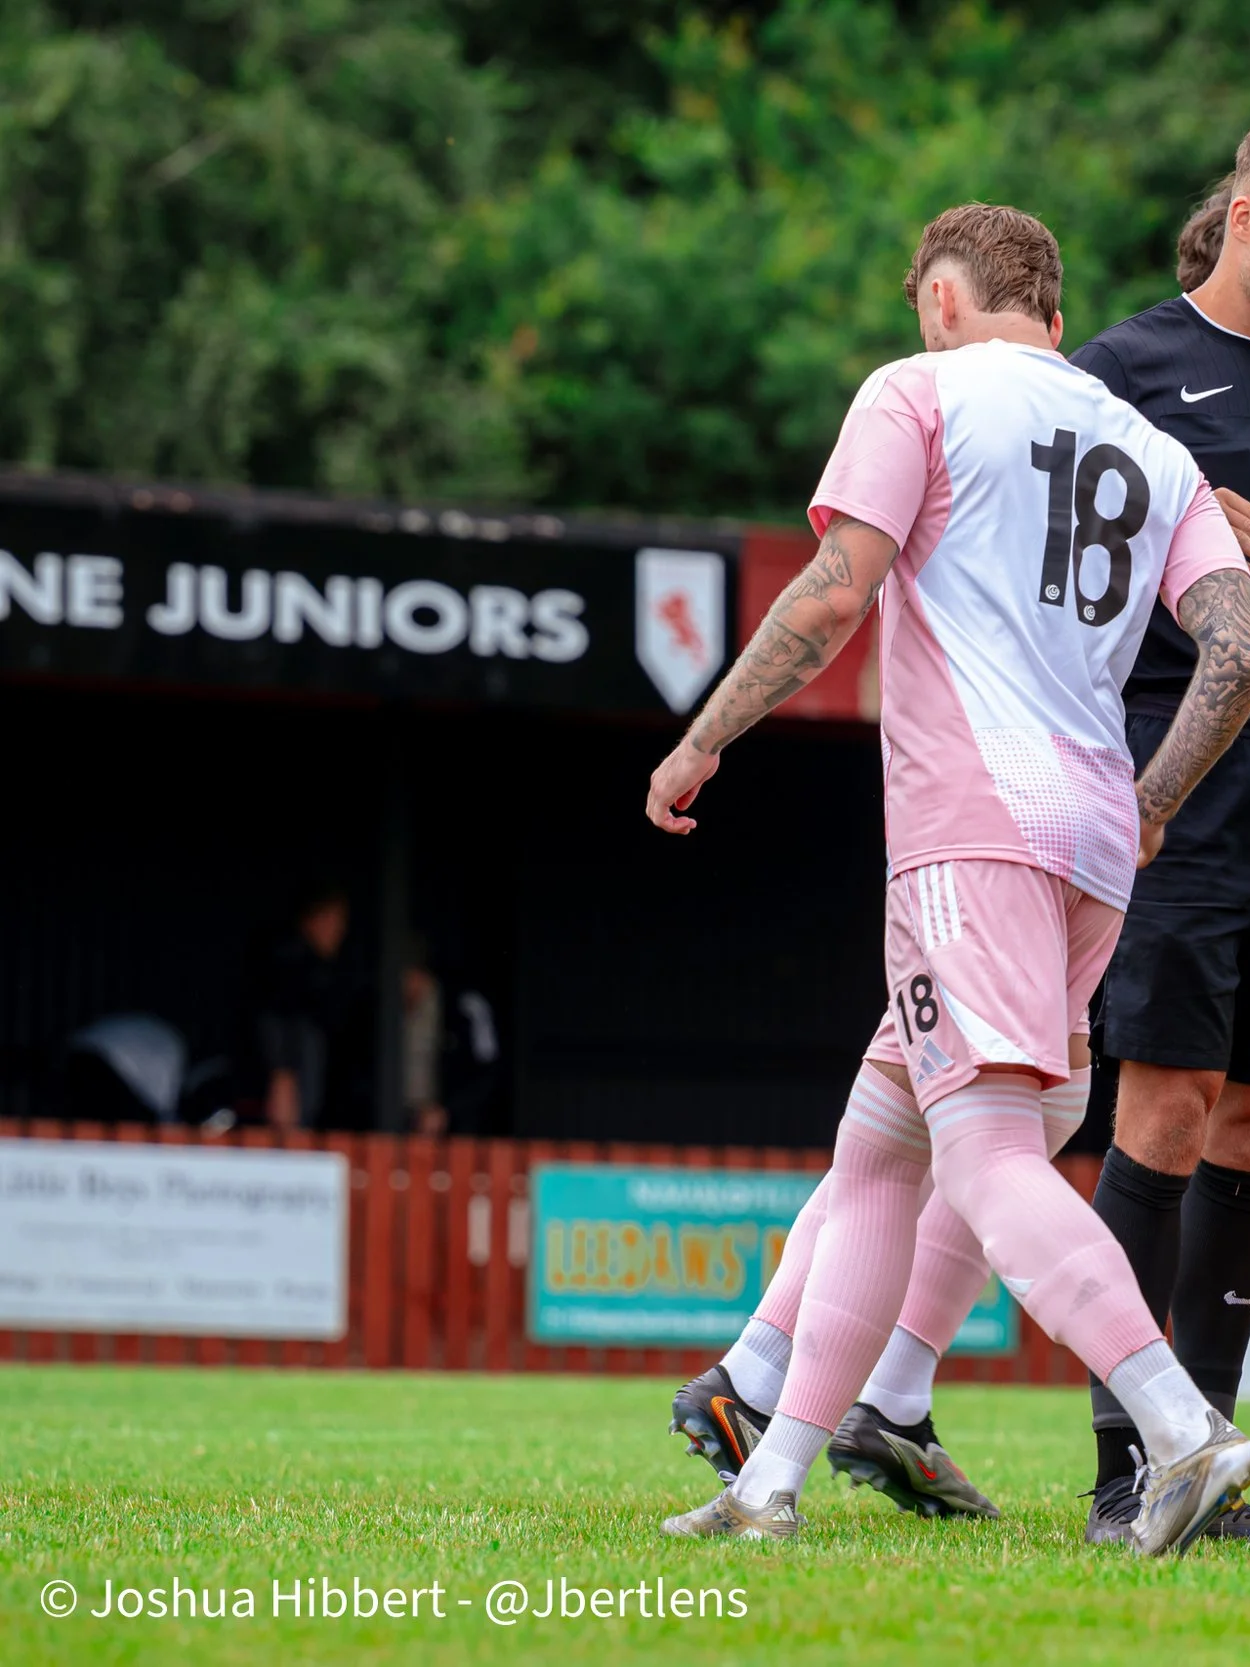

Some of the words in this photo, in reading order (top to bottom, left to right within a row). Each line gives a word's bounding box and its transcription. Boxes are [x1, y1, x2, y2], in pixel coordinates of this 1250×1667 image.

[1030, 427, 1151, 628] 18
[146, 562, 591, 664] JUNIORS
[896, 973, 939, 1047] 18
